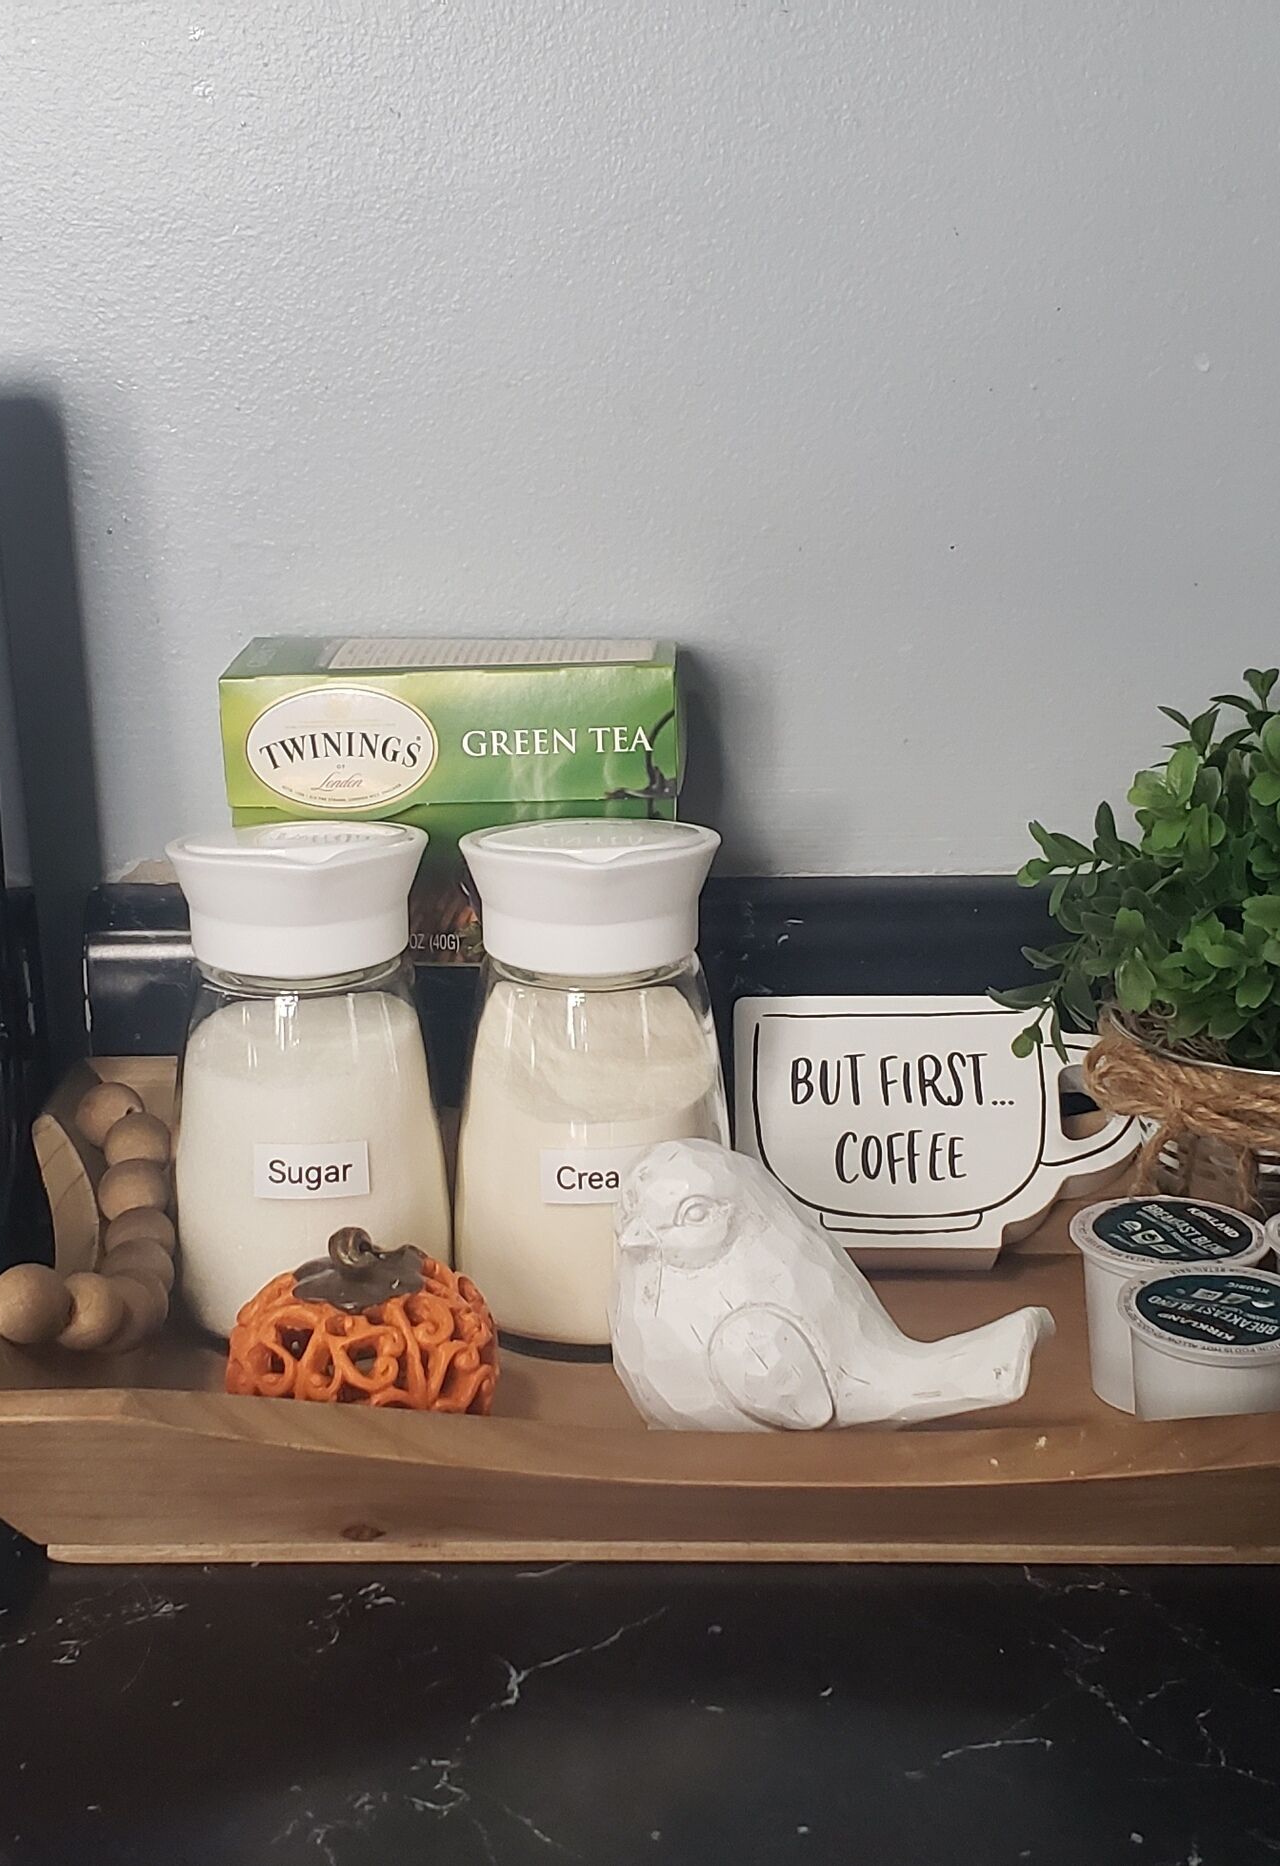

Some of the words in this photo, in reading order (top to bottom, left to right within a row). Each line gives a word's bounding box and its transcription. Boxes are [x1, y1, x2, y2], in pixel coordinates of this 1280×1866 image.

[259, 731, 422, 770] TWININGS
[462, 728, 577, 757] GREEN
[588, 726, 654, 753] TEA
[310, 771, 362, 792] London
[410, 934, 425, 949] OZ
[429, 933, 460, 952] (40G)
[791, 1053, 866, 1106] BUT
[880, 1052, 1015, 1107] FIRST...
[835, 1130, 968, 1185] COFFEE
[267, 1159, 353, 1191] Sugar
[555, 1166, 621, 1189] Crea
[1186, 1206, 1240, 1239] KIRKLAND
[1224, 1281, 1270, 1295] KEURIG
[1156, 1312, 1237, 1342] KIRKLAND
[1192, 1305, 1280, 1336] BREAKFAST
